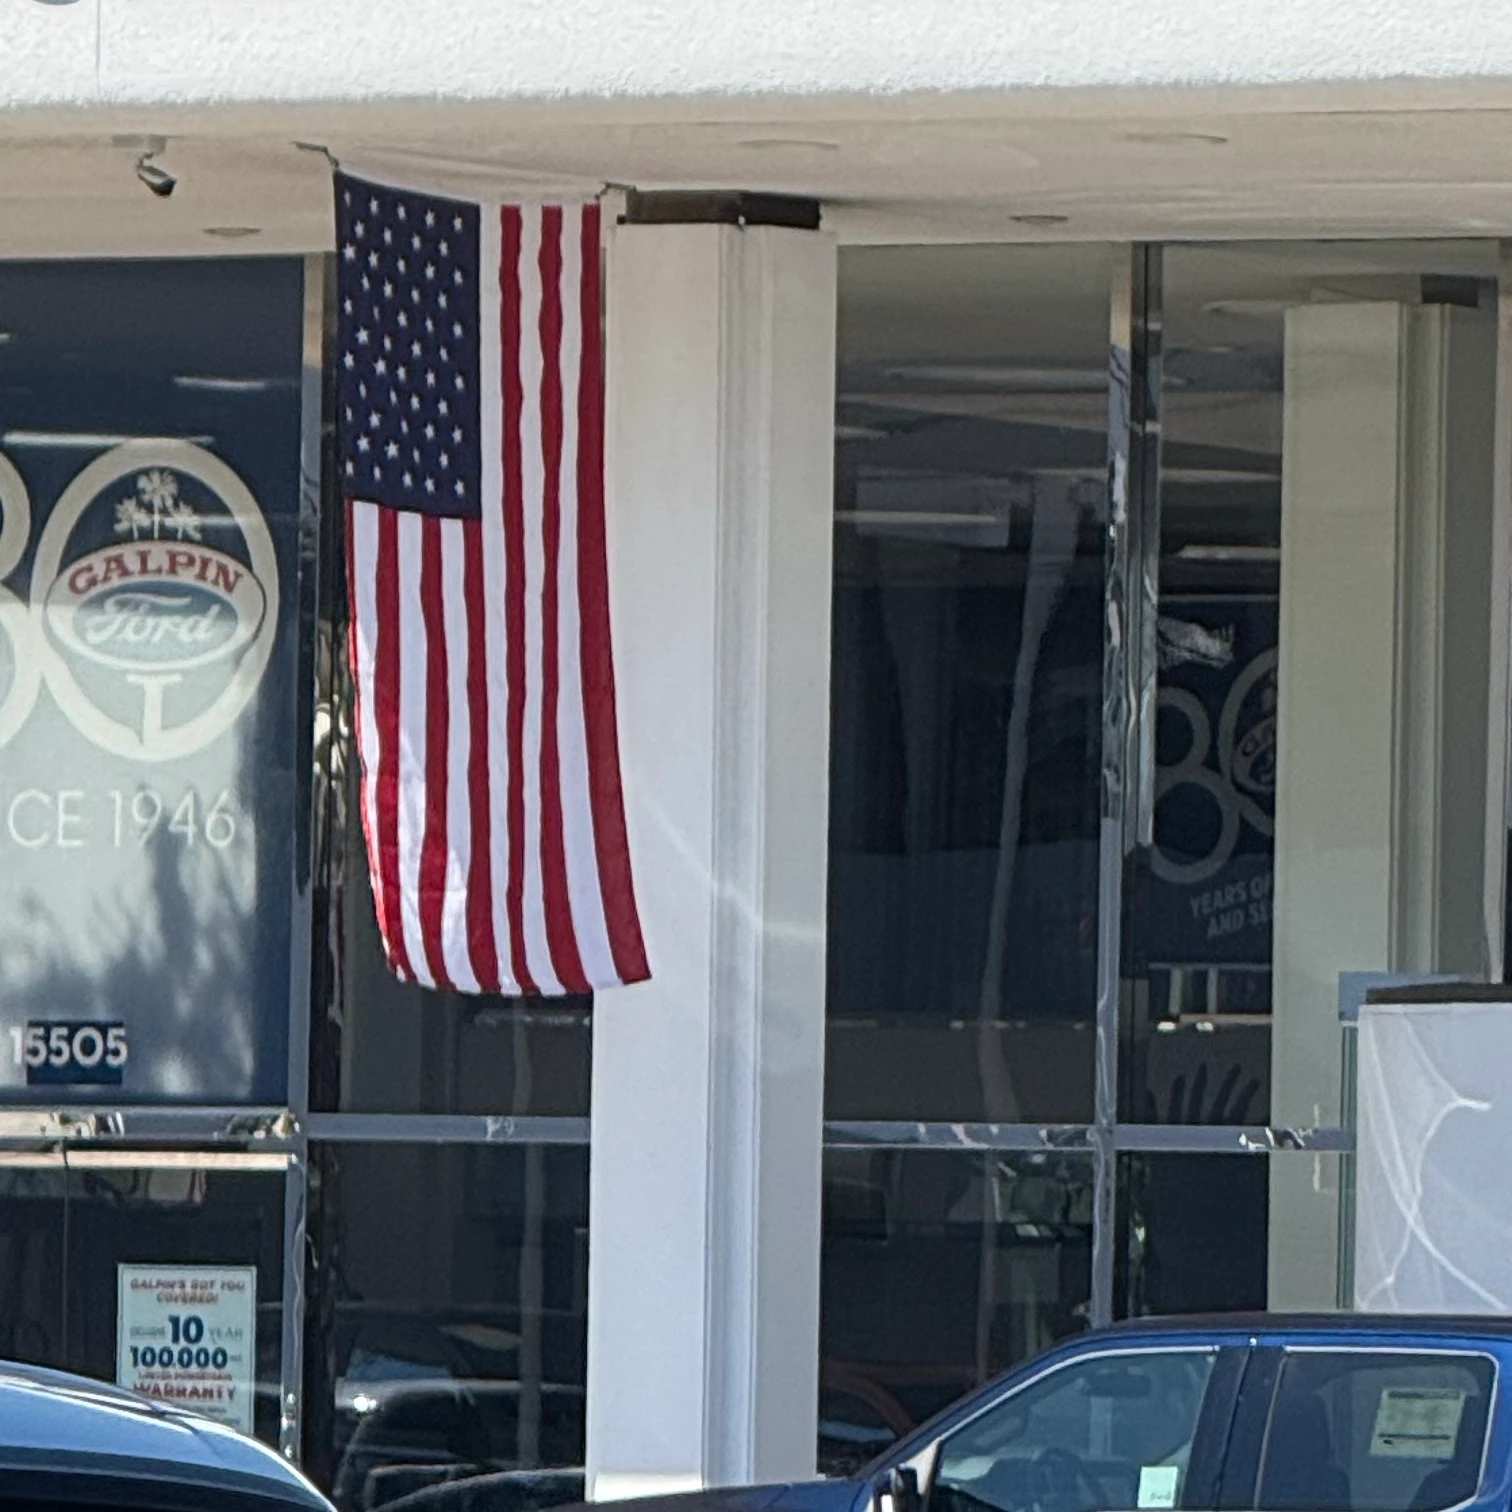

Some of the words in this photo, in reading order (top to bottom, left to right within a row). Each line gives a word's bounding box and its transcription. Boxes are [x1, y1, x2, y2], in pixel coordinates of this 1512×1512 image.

[68, 550, 243, 595] GALPIN
[86, 593, 215, 644] Ford
[110, 787, 236, 848] 1946
[1192, 884, 1247, 917] YEARS
[1207, 911, 1245, 937] AND
[9, 1027, 128, 1068] 15505
[168, 1315, 204, 1344] 10
[133, 1381, 236, 1400] WARRANTY
